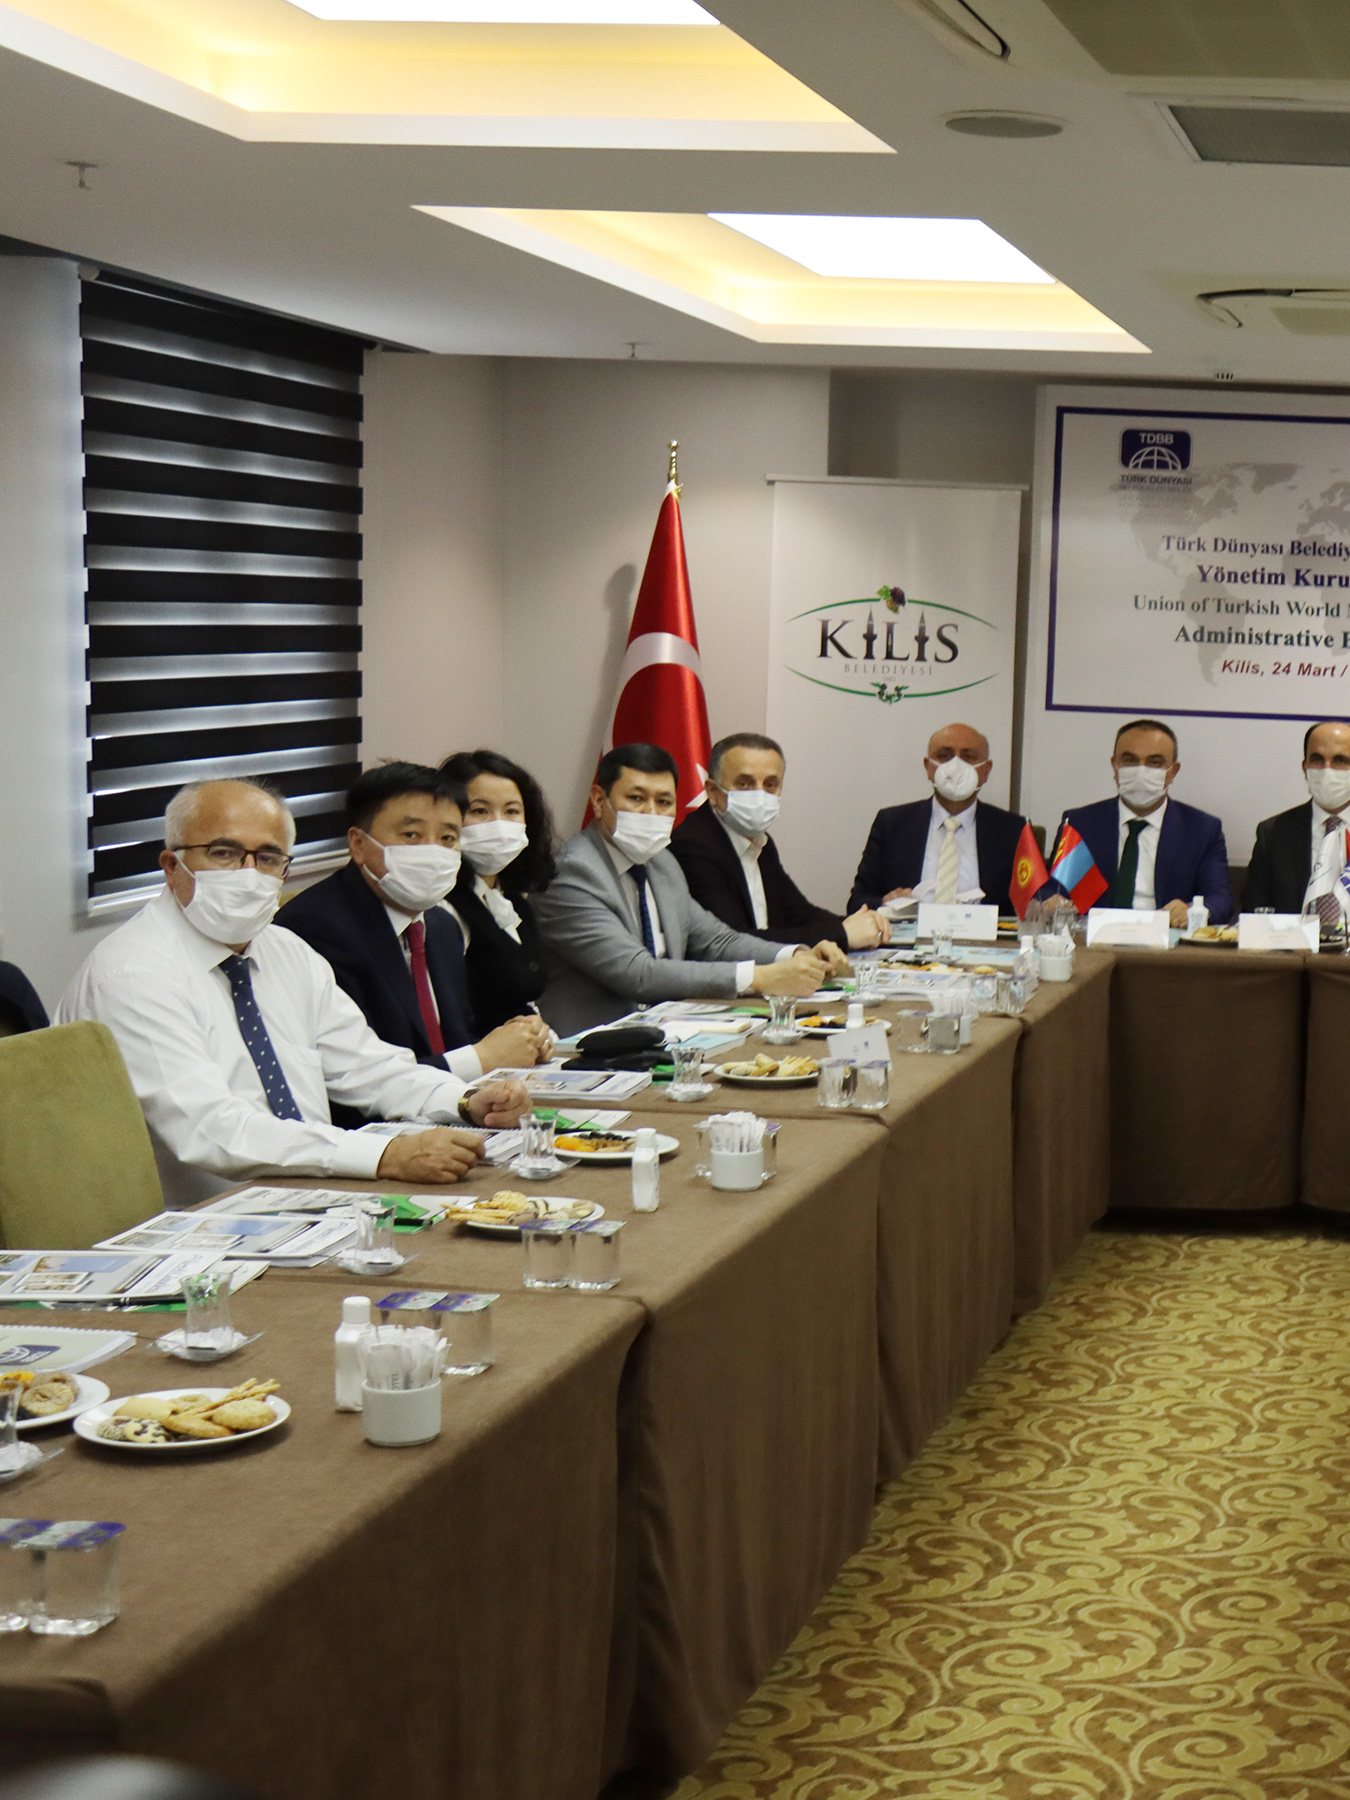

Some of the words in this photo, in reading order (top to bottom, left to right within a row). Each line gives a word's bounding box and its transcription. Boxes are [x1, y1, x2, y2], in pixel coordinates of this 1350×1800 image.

[1139, 432, 1174, 444] TDBB
[1162, 535, 1207, 552] Türk
[1213, 536, 1284, 558] Dünyası
[1197, 564, 1286, 586] Yönetim
[1134, 594, 1186, 612] Union
[1191, 597, 1210, 613] of
[1211, 598, 1280, 616] Turkish
[1286, 601, 1341, 618] World
[1174, 625, 1335, 648] Administrative
[1221, 659, 1265, 677] Kilis,
[1271, 661, 1292, 676] 24
[1297, 662, 1336, 678] Mart
[1340, 664, 1349, 678] /
